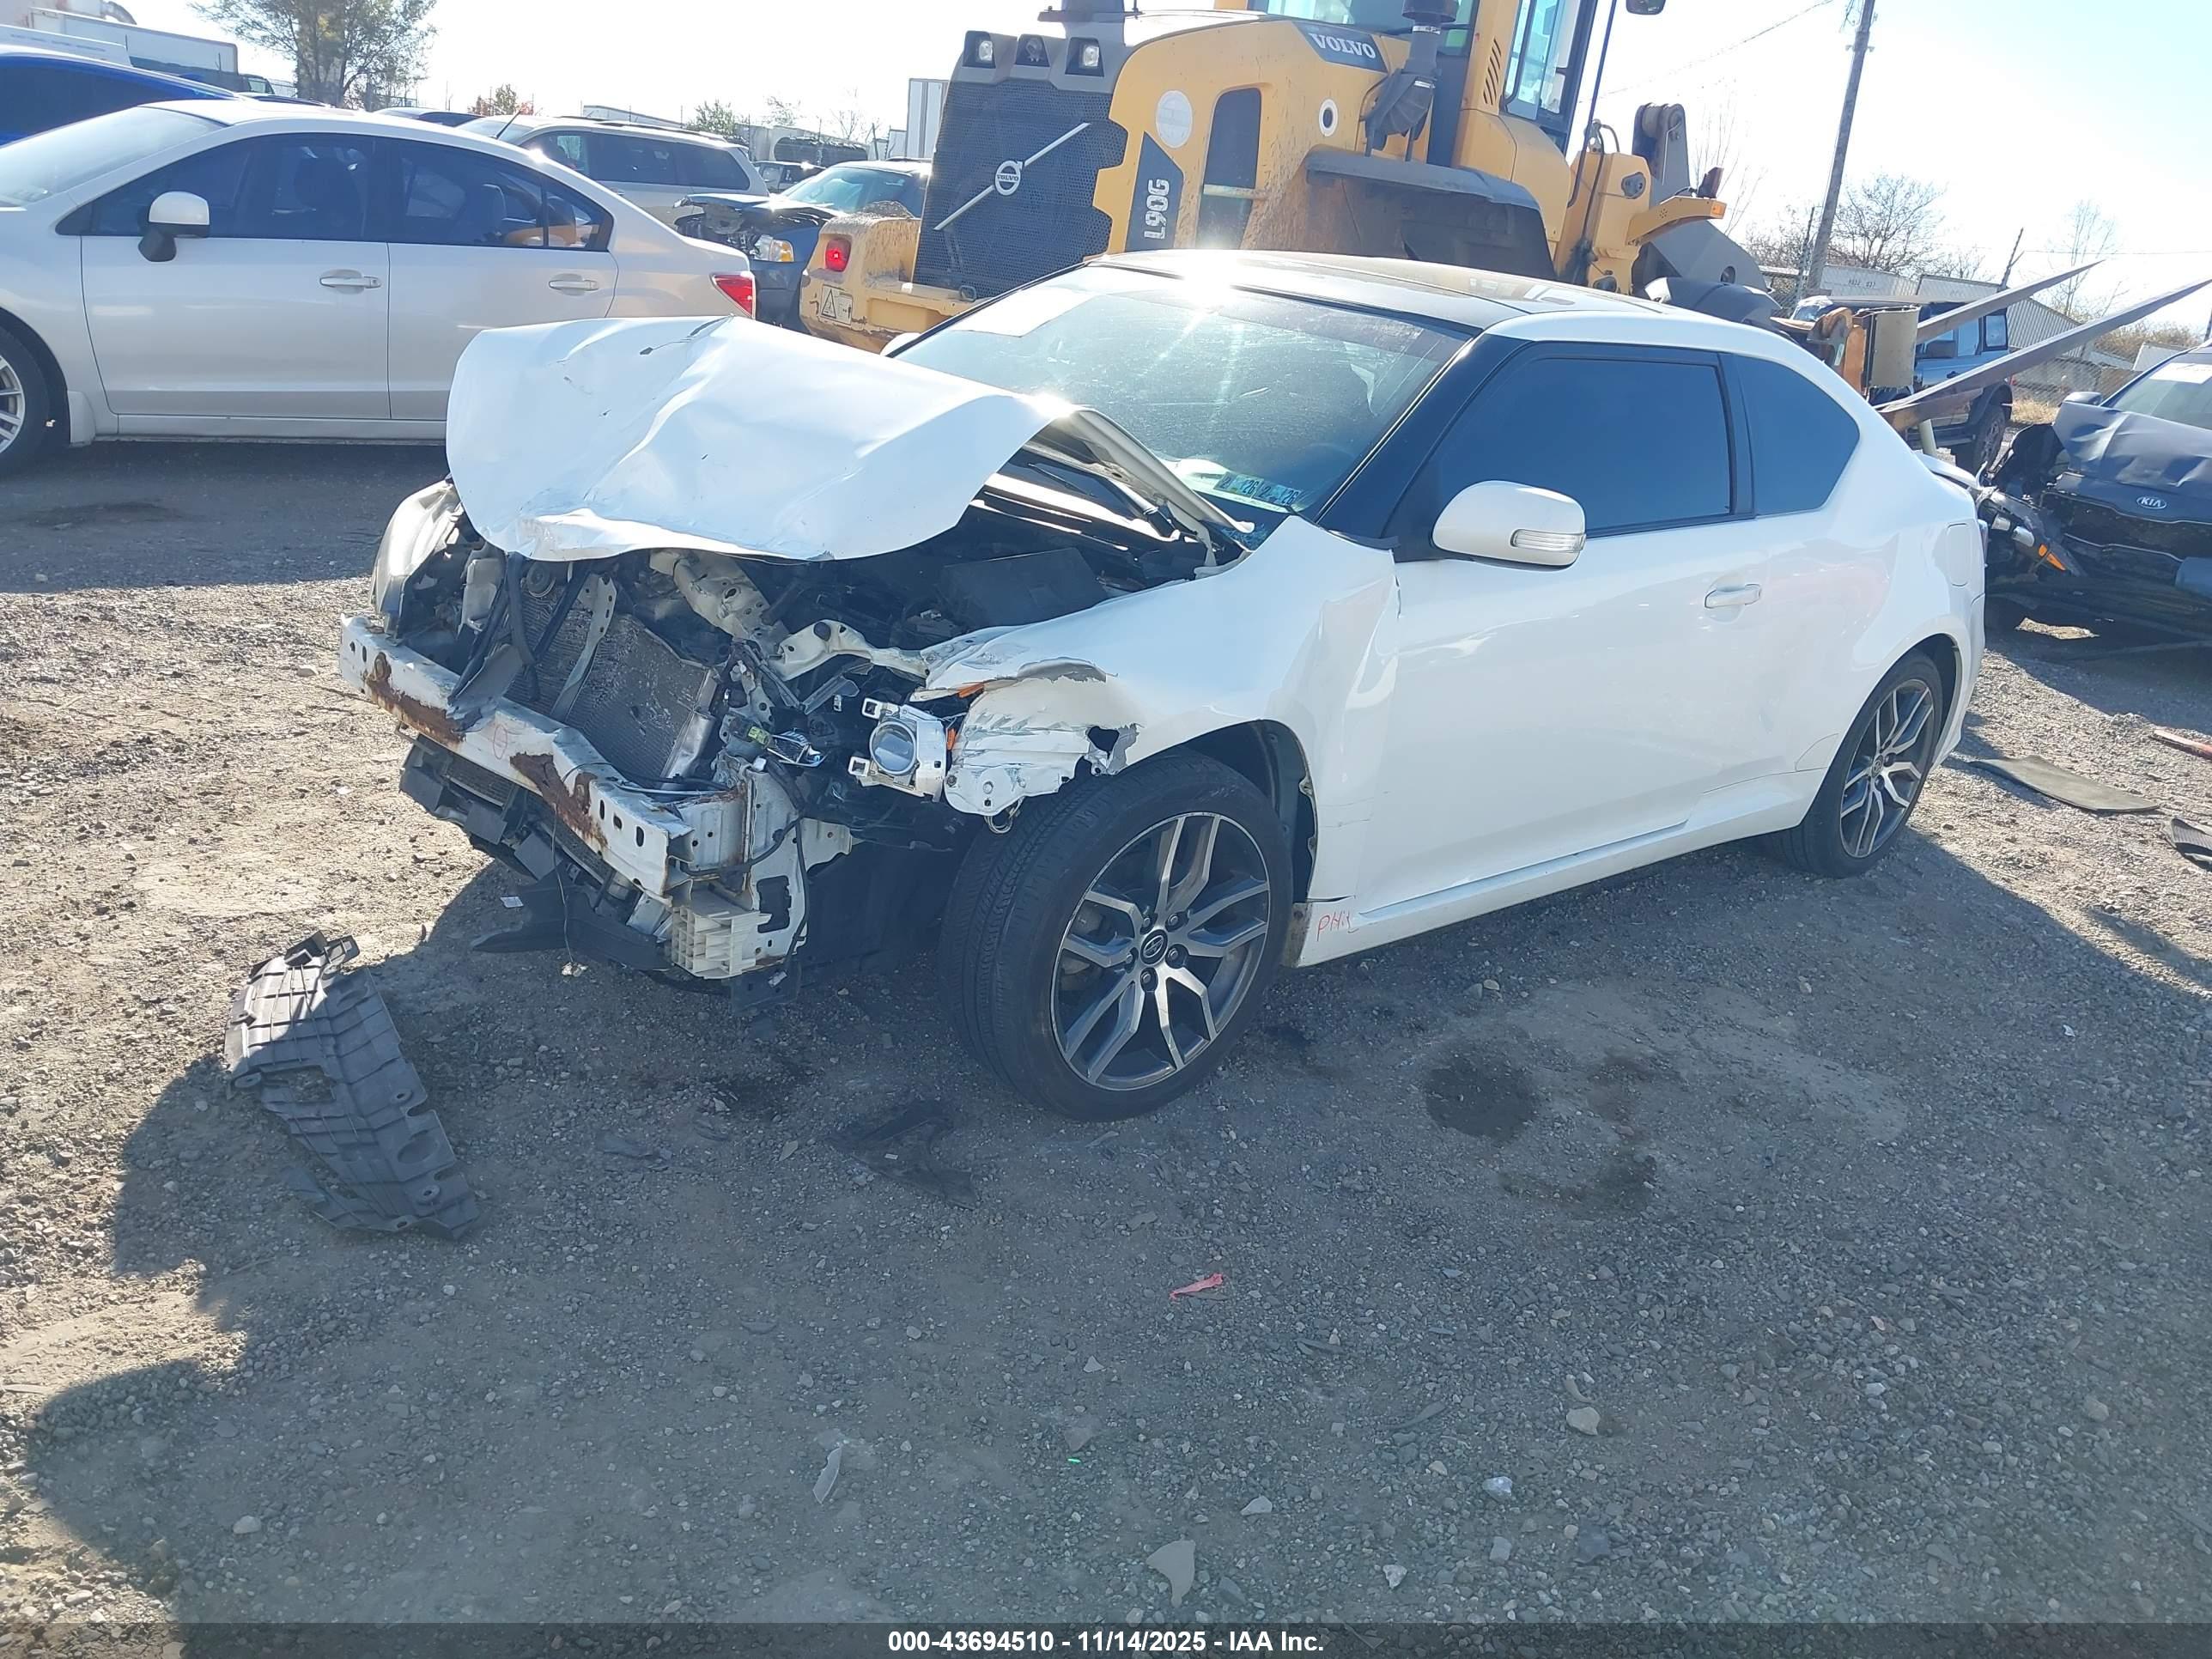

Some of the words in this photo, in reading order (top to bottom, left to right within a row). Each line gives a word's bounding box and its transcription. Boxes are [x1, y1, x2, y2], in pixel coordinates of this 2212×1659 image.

[1308, 33, 1376, 59] VOLVO
[1143, 178, 1170, 240] L90G
[2141, 497, 2162, 507] KIA
